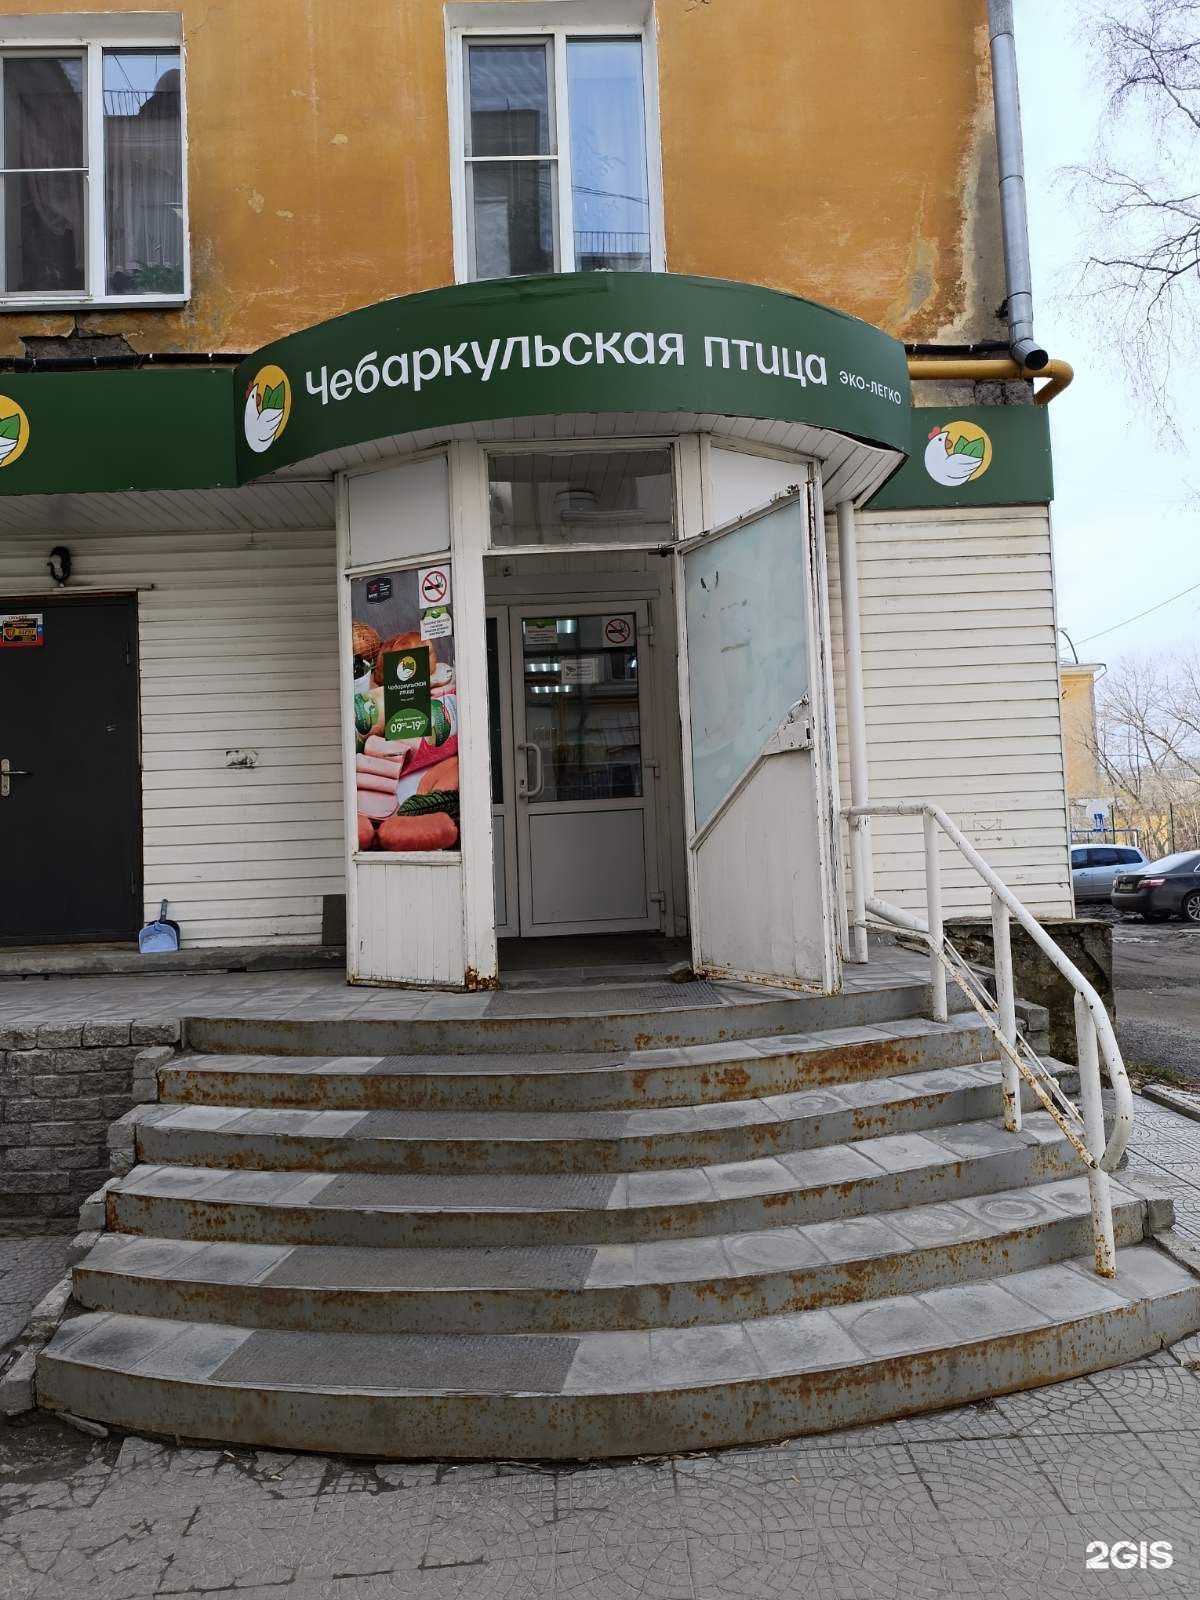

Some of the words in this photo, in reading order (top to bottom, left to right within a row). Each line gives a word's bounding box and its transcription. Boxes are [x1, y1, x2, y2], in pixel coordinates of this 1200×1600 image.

[305, 331, 685, 405] Чебаркульская
[703, 335, 828, 388] птица
[839, 370, 902, 405] ЭКО-ЛЕГКО
